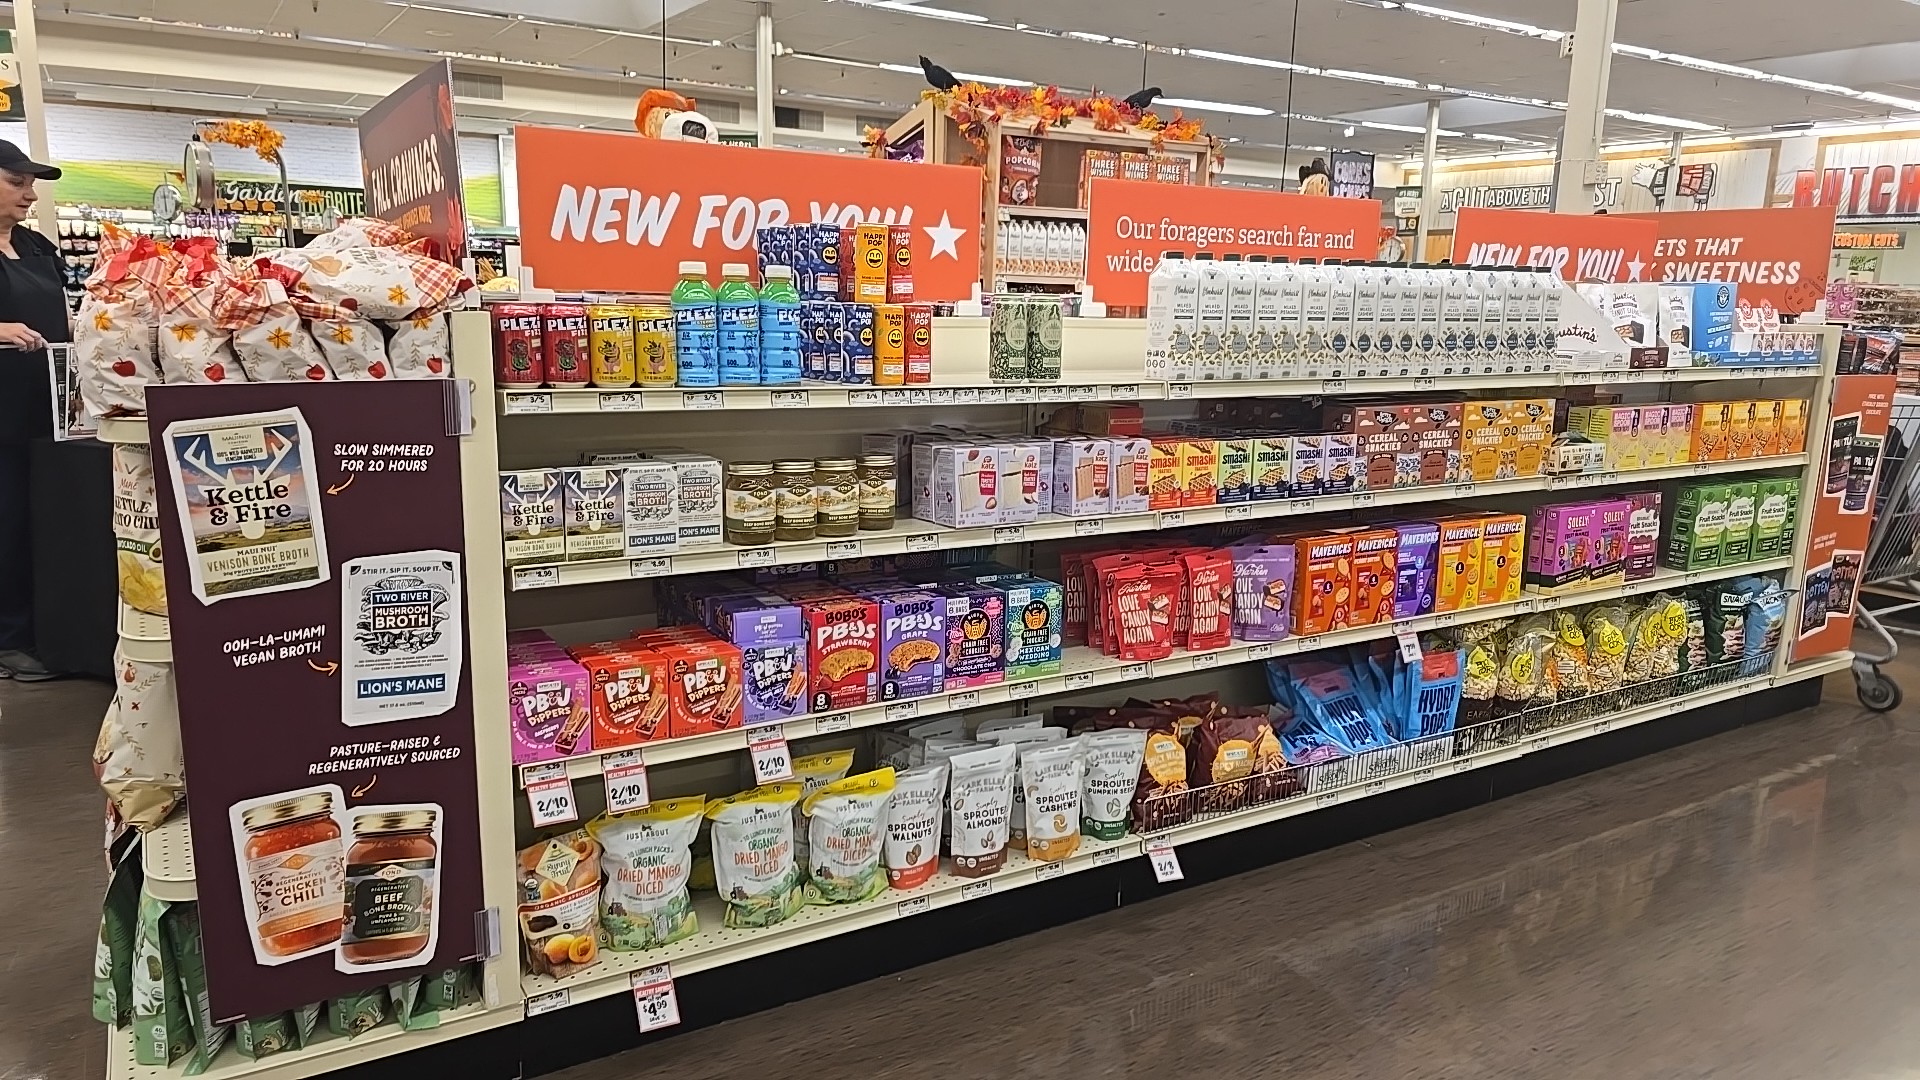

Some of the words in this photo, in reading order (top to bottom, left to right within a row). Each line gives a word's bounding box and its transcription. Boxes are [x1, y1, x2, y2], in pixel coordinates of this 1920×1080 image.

[1090, 158, 1115, 170] THREE
[1125, 160, 1149, 172] THREE
[1157, 163, 1181, 174] THREE
[371, 163, 391, 218] FALL
[390, 133, 445, 208] CRAVINGS.
[1090, 168, 1115, 178] WISHES
[1124, 170, 1149, 180] WISHES
[1157, 173, 1181, 183] WISHES
[1441, 190, 1449, 209] A
[1452, 186, 1490, 208] CUT
[1488, 188, 1529, 207] ABOVE
[1532, 185, 1551, 204] TH
[550, 183, 681, 248] NEW
[1116, 215, 1155, 240] Our
[1159, 218, 1235, 248] foragers
[1237, 225, 1293, 247] search
[1296, 226, 1321, 249] far
[1324, 229, 1355, 250] and
[867, 239, 883, 247] POP
[895, 238, 910, 246] POP
[1653, 238, 1687, 257] ETS
[1695, 237, 1744, 257] THAT
[1834, 233, 1872, 247] CUSTOM
[1874, 233, 1900, 247] CUTS
[1106, 249, 1152, 273] wide
[1467, 242, 1522, 267] NEW
[1527, 245, 1569, 281] FOR
[1575, 247, 1624, 283] YOU!
[1662, 260, 1801, 285] SWEETNESS
[1557, 323, 1599, 343] ustin's
[1369, 433, 1399, 443] CEREAL
[1423, 430, 1450, 440] CEREAL
[333, 443, 369, 457] SLOW
[372, 444, 435, 457] SIMMERED
[1365, 442, 1401, 453] SNACKIES
[1419, 438, 1453, 449] SNACKIES
[981, 461, 995, 470] katz
[1095, 454, 1108, 463] katz
[340, 460, 365, 473] FOR
[368, 459, 384, 472] 20
[388, 459, 428, 472] HOURS
[204, 479, 289, 508] Kettle
[637, 491, 666, 499] MUSHROOM
[512, 499, 554, 516] Kettle
[574, 499, 615, 511] Kettle
[637, 496, 666, 506] BROTH
[209, 507, 229, 526] &
[235, 501, 292, 525] Fire
[513, 515, 523, 527] &
[526, 513, 555, 526] Fire
[575, 511, 585, 522] &
[587, 509, 615, 521] Fire
[630, 536, 654, 545] LION'S
[655, 534, 676, 543] MANE
[1445, 527, 1482, 541] MAVERICKS
[1311, 543, 1351, 559] MAVERICKS
[1356, 537, 1398, 551] MAVERICKS
[237, 547, 257, 557] MAUI
[207, 558, 250, 573] VENISON
[252, 553, 276, 568] BONE
[279, 548, 310, 564] BROTH
[362, 567, 379, 575] STIR
[389, 566, 402, 574] SIP
[412, 566, 430, 574] SOUP
[431, 565, 442, 573] IT.
[375, 593, 397, 603] TWO
[400, 591, 429, 602] RIVER
[1193, 587, 1213, 600] LOVE
[375, 605, 429, 616] MUSHROOM
[894, 600, 935, 617] BOBO'S
[1118, 594, 1140, 613] LOVE
[1193, 602, 1219, 618] CANDY
[375, 614, 429, 629] BROTH
[825, 607, 867, 625] BOBO'S
[1121, 611, 1151, 628] CANDY
[1192, 618, 1219, 635] AGAIN
[223, 624, 326, 654] OOH-LA-UMAMI
[901, 631, 928, 640] GRAPE
[1123, 627, 1155, 645] AGAIN
[232, 649, 275, 668] VEGAN
[279, 641, 322, 660] BROTH
[821, 639, 872, 656] STRAWBERRY
[1018, 646, 1049, 654] MEXICAN
[1018, 651, 1049, 660] WEDDING
[360, 680, 402, 696] LION'S
[405, 677, 444, 692] MANE
[816, 694, 826, 705] 8
[814, 703, 828, 712] PACK
[329, 737, 430, 758] PASTURE-RAISED
[432, 735, 441, 746] &
[308, 753, 407, 776] REGENERATIVELY
[410, 748, 460, 764] SOURCED
[1088, 787, 1117, 795] PUMPKIN
[1039, 800, 1077, 813] CASHEWS
[888, 818, 934, 832] SPROUTED
[626, 831, 641, 841] JUST
[642, 828, 669, 838] ABOUT
[892, 828, 932, 842] WALNUTS
[748, 836, 780, 851] ORGANIC
[734, 850, 760, 865] DRIED
[764, 840, 789, 858] MANGO
[632, 855, 667, 868] ORGANIC
[754, 860, 779, 877] DICED
[617, 869, 644, 883] DRIED
[647, 864, 681, 879] MANGO
[275, 877, 327, 897] CHICKEN
[635, 881, 664, 896] DICED
[280, 887, 325, 907] CHILI
[374, 893, 403, 904] BEEF
[364, 904, 387, 917] BONE
[387, 902, 413, 913] BROTH
